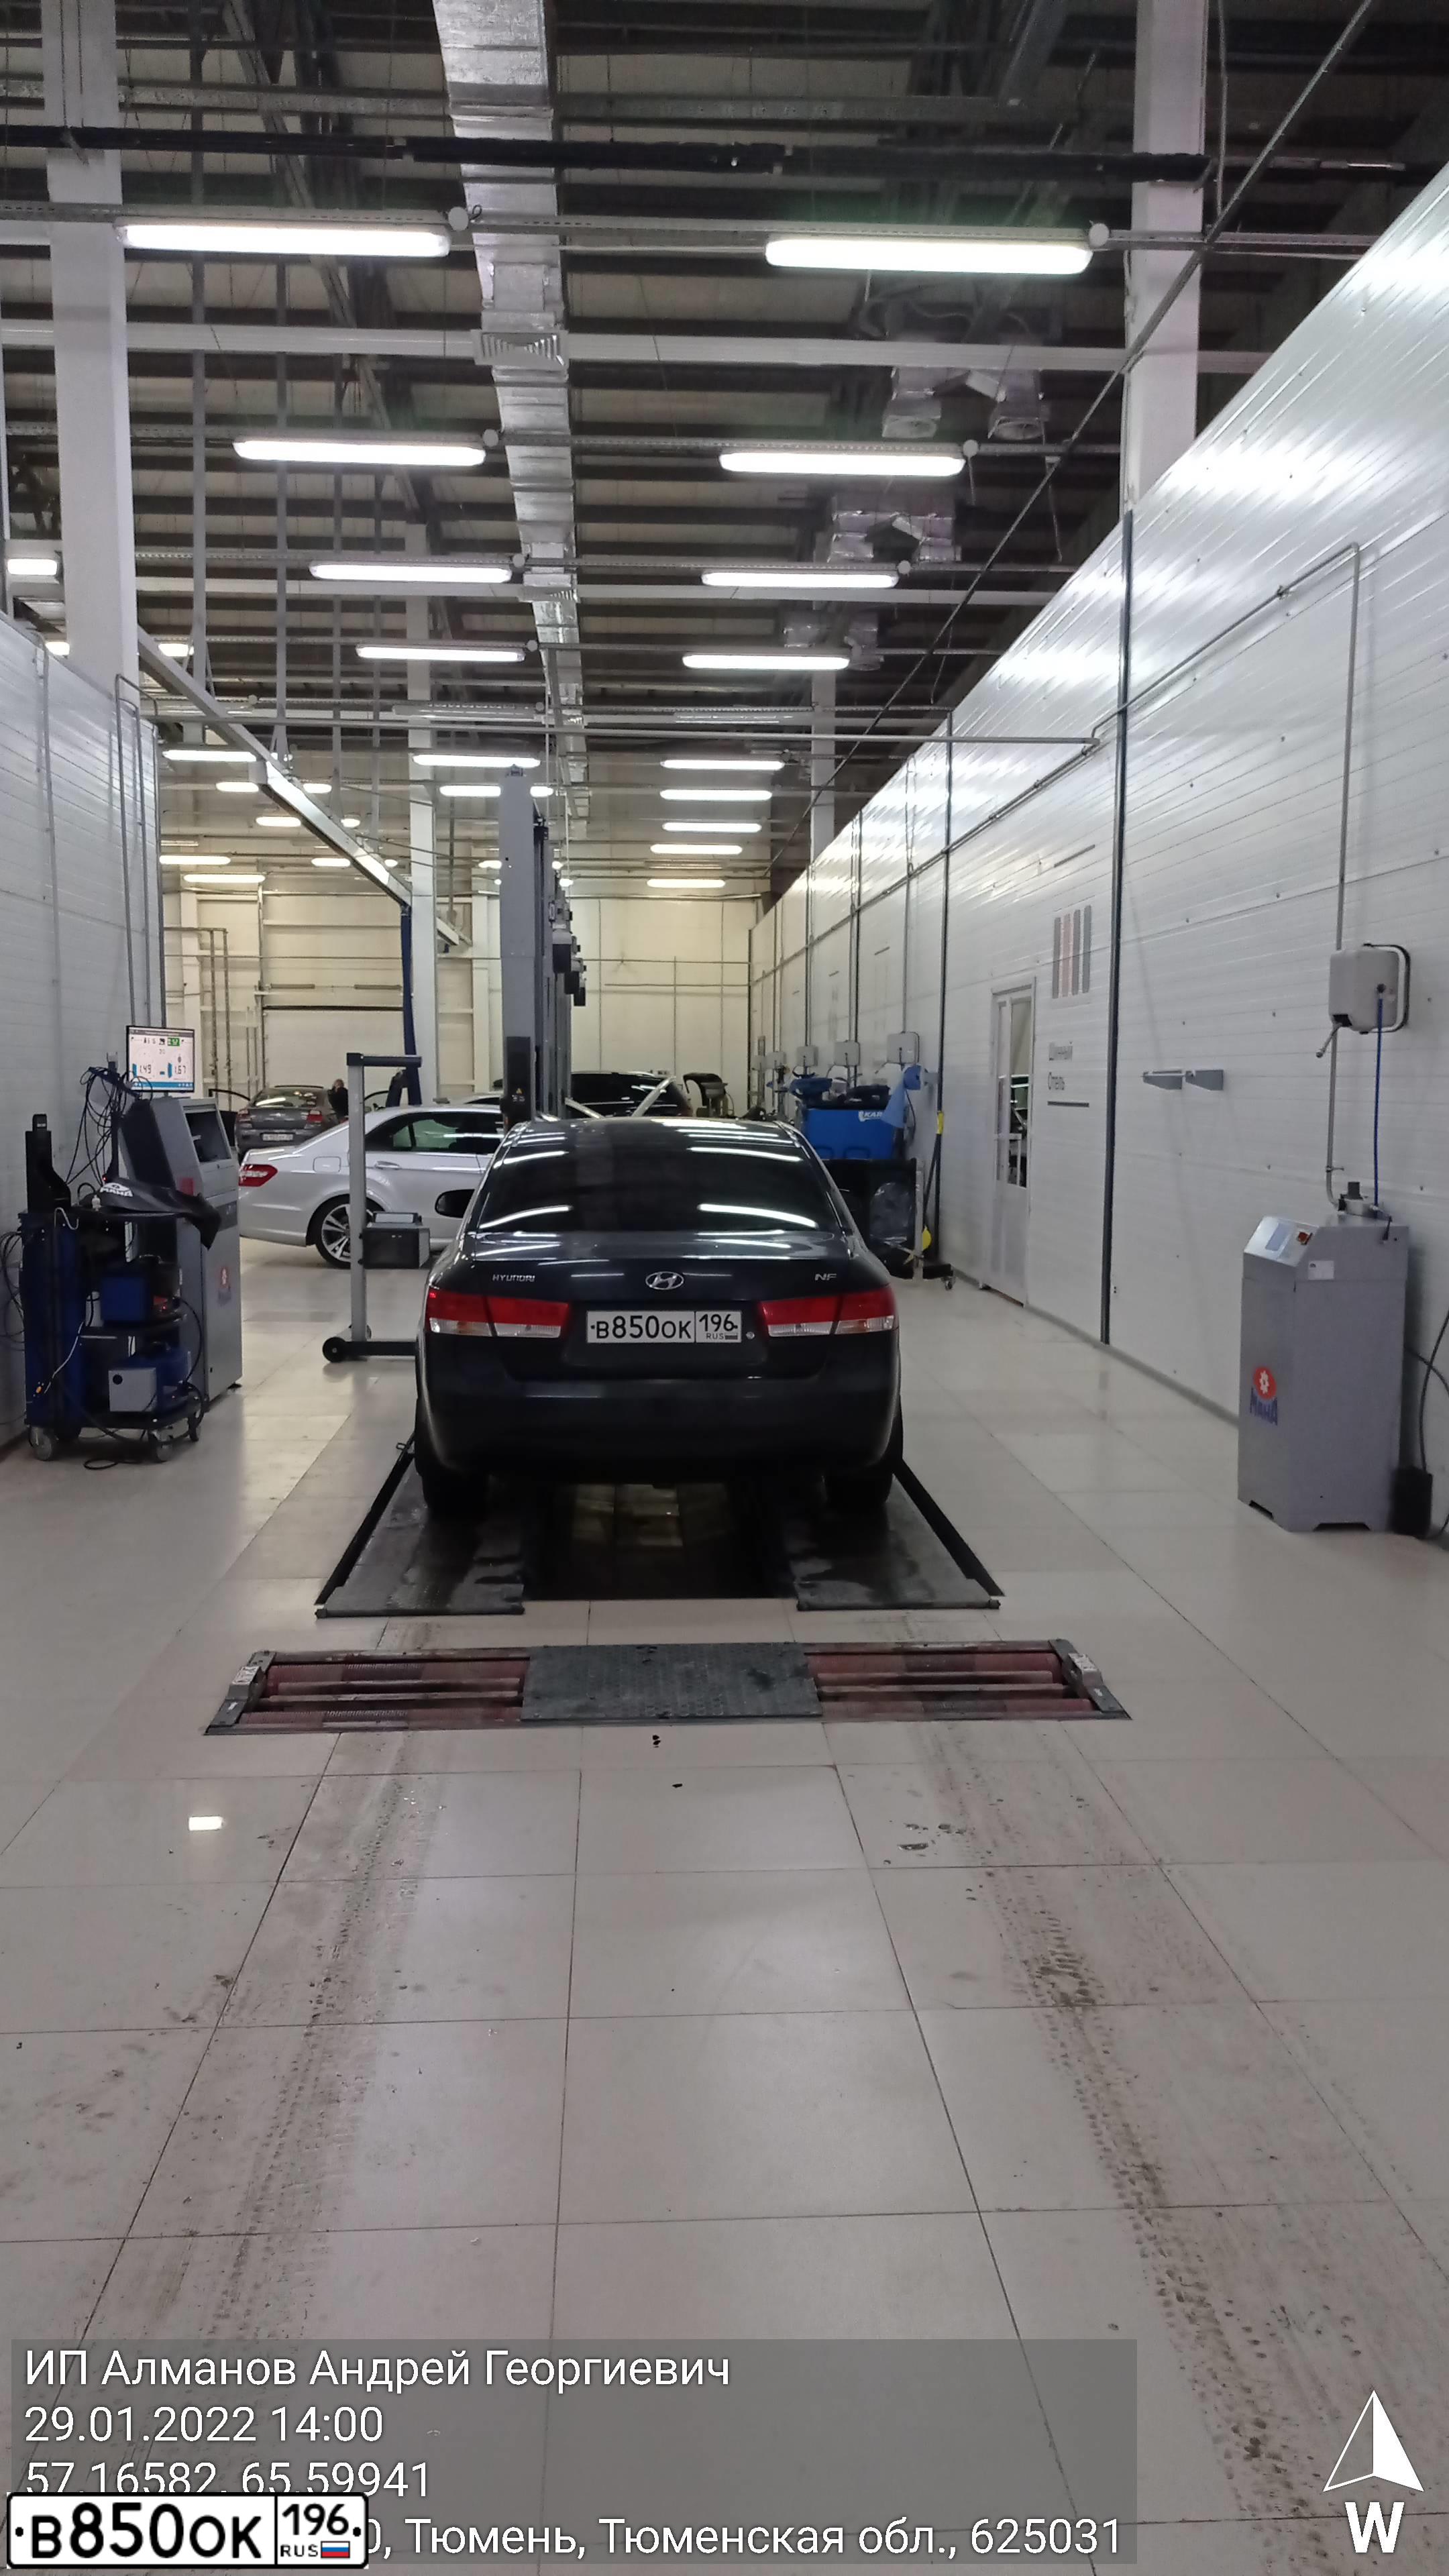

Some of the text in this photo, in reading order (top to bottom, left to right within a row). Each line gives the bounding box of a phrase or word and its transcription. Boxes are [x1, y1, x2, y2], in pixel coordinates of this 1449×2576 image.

[492, 1274, 536, 1283] HYUNDAI
[814, 1273, 837, 1281] NF
[596, 1313, 734, 1339] В850ОК 196
